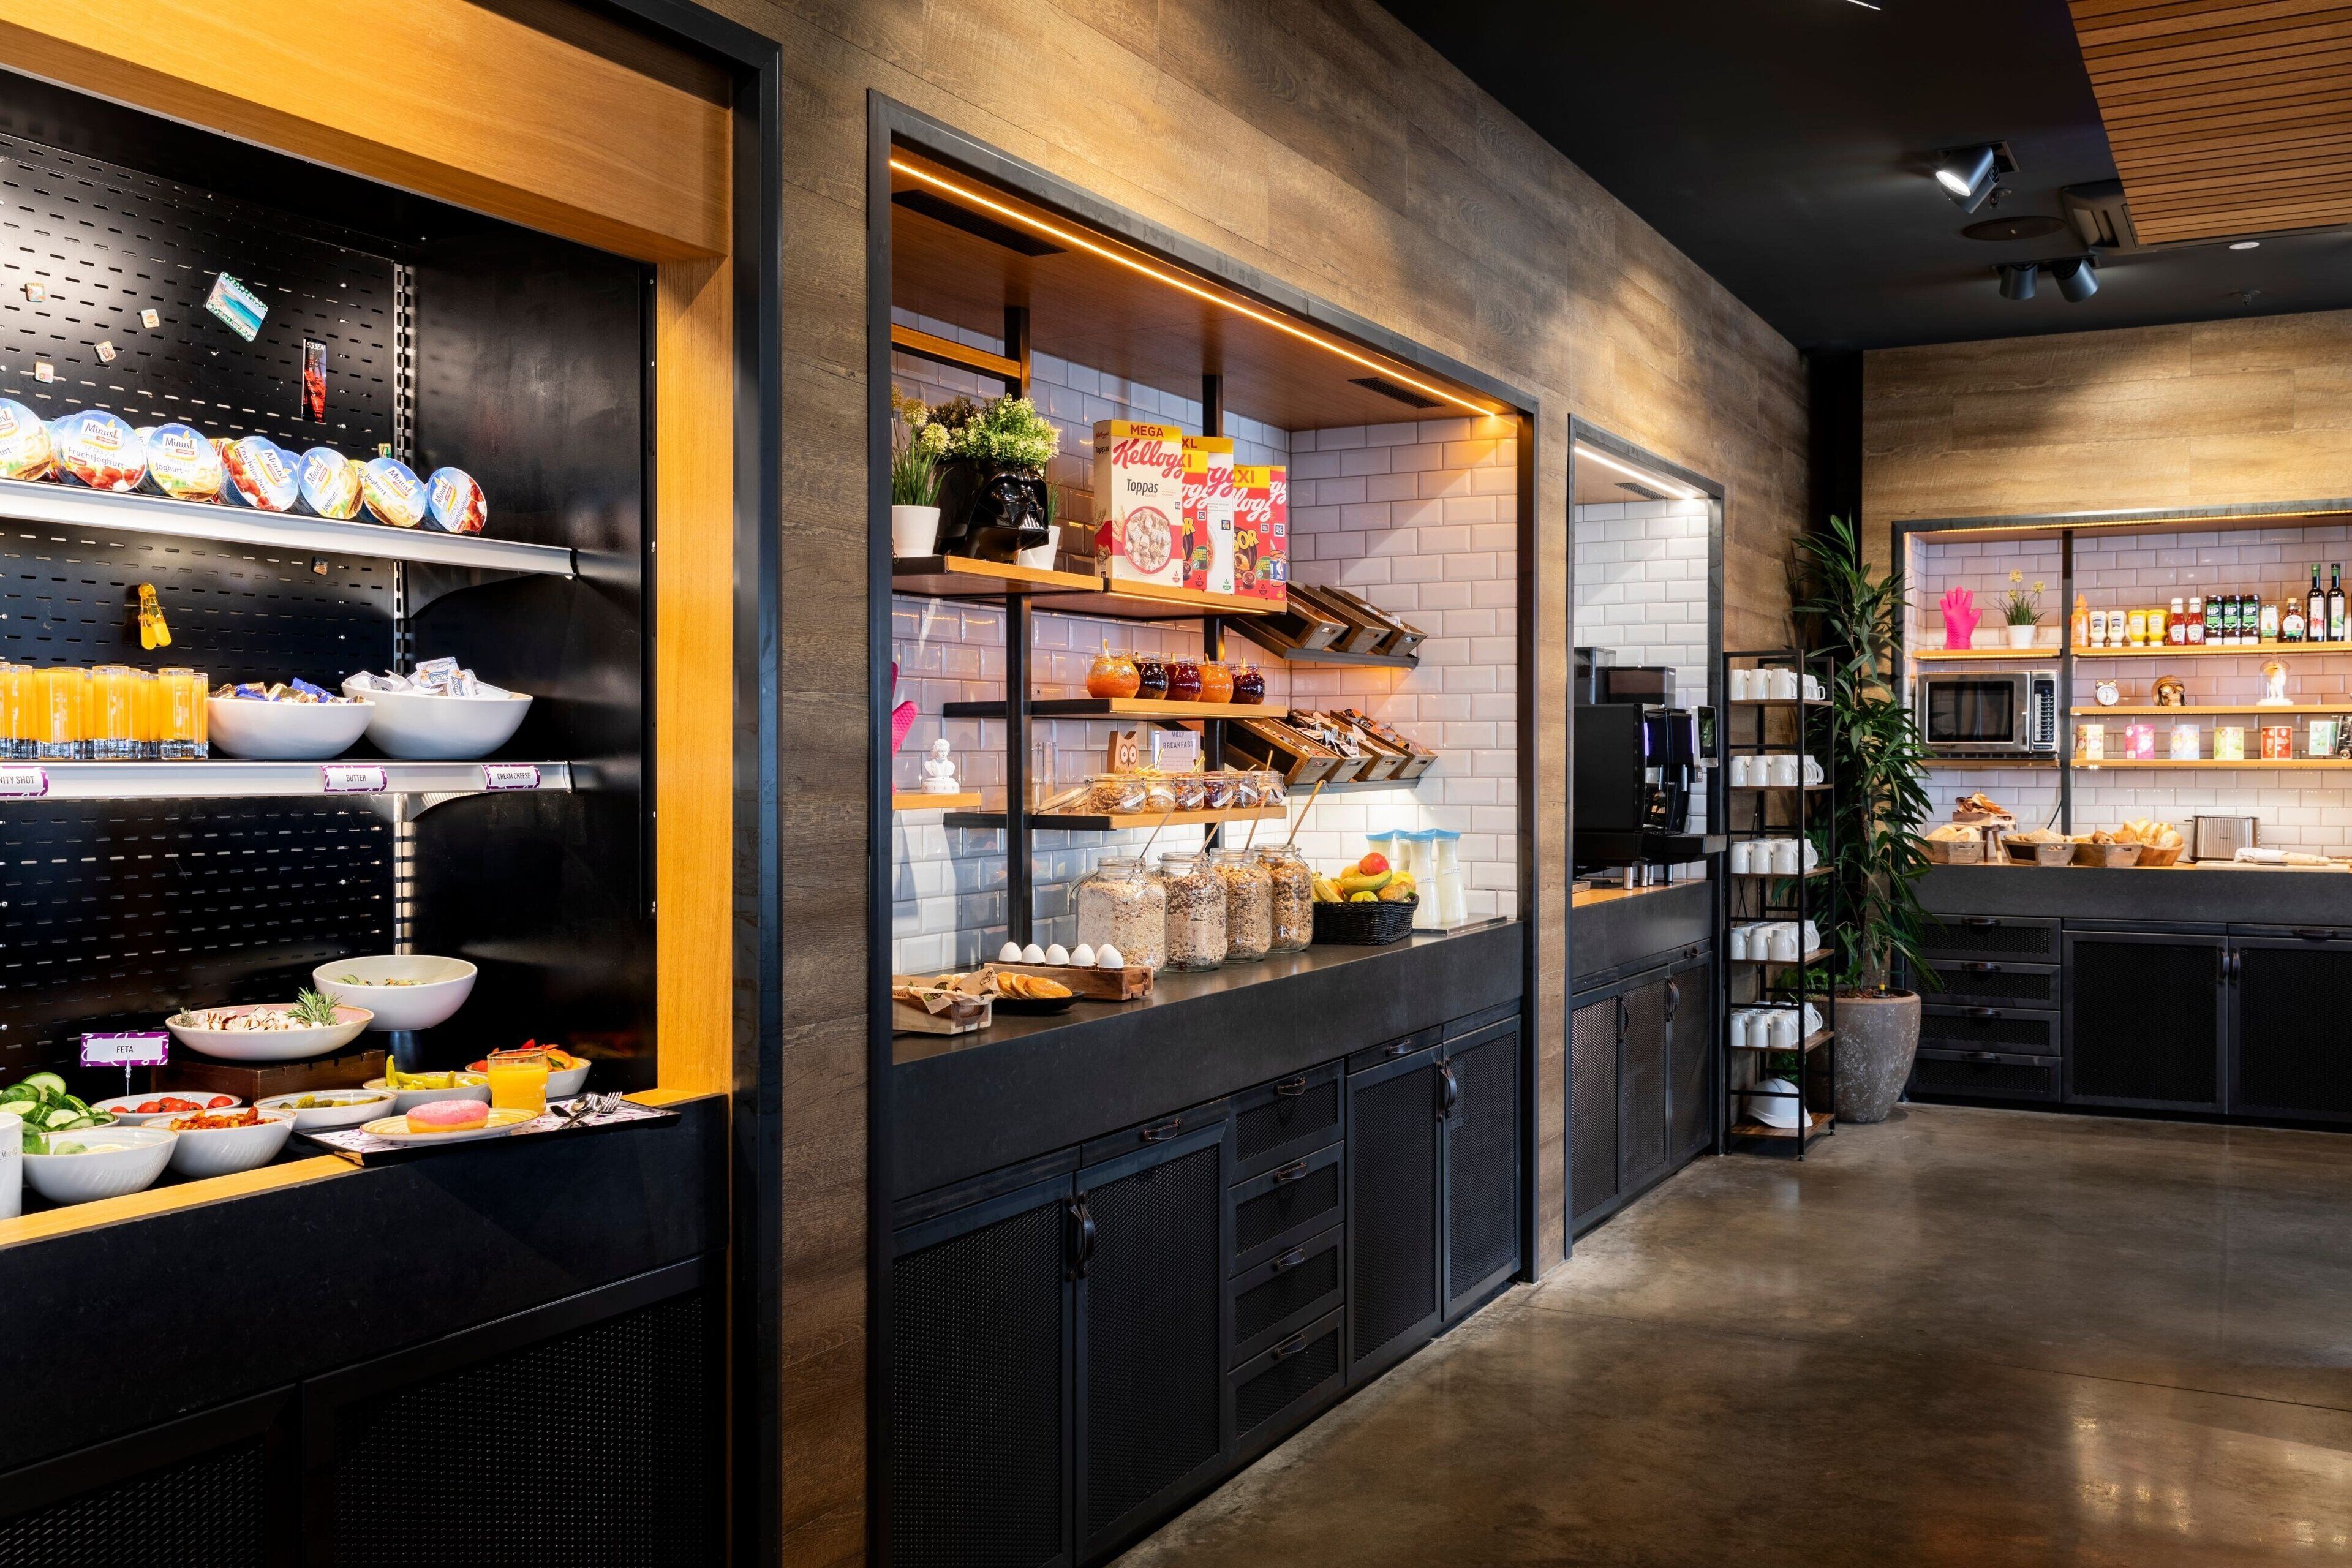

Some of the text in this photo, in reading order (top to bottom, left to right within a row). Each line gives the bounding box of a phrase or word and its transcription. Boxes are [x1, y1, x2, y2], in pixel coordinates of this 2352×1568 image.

[306, 342, 326, 351] ESSEN
[85, 423, 118, 439] MinusL
[1130, 424, 1164, 437] MEGA
[165, 437, 194, 449] MinusL
[1095, 446, 1109, 455] Toppas
[69, 447, 124, 469] Fruchtjoghurt
[264, 453, 287, 478] MinusL
[156, 462, 183, 475] Joghurt
[239, 445, 268, 494] Fruchtjoghurt
[366, 473, 386, 496] Joghurt
[388, 470, 413, 493] MinusL
[1126, 478, 1158, 496] Toppas
[322, 491, 339, 513] Joghurt
[451, 493, 470, 530] Fruchtjoghurt
[1163, 741, 1193, 749] BREAKFAST
[15, 775, 34, 784] SHOT
